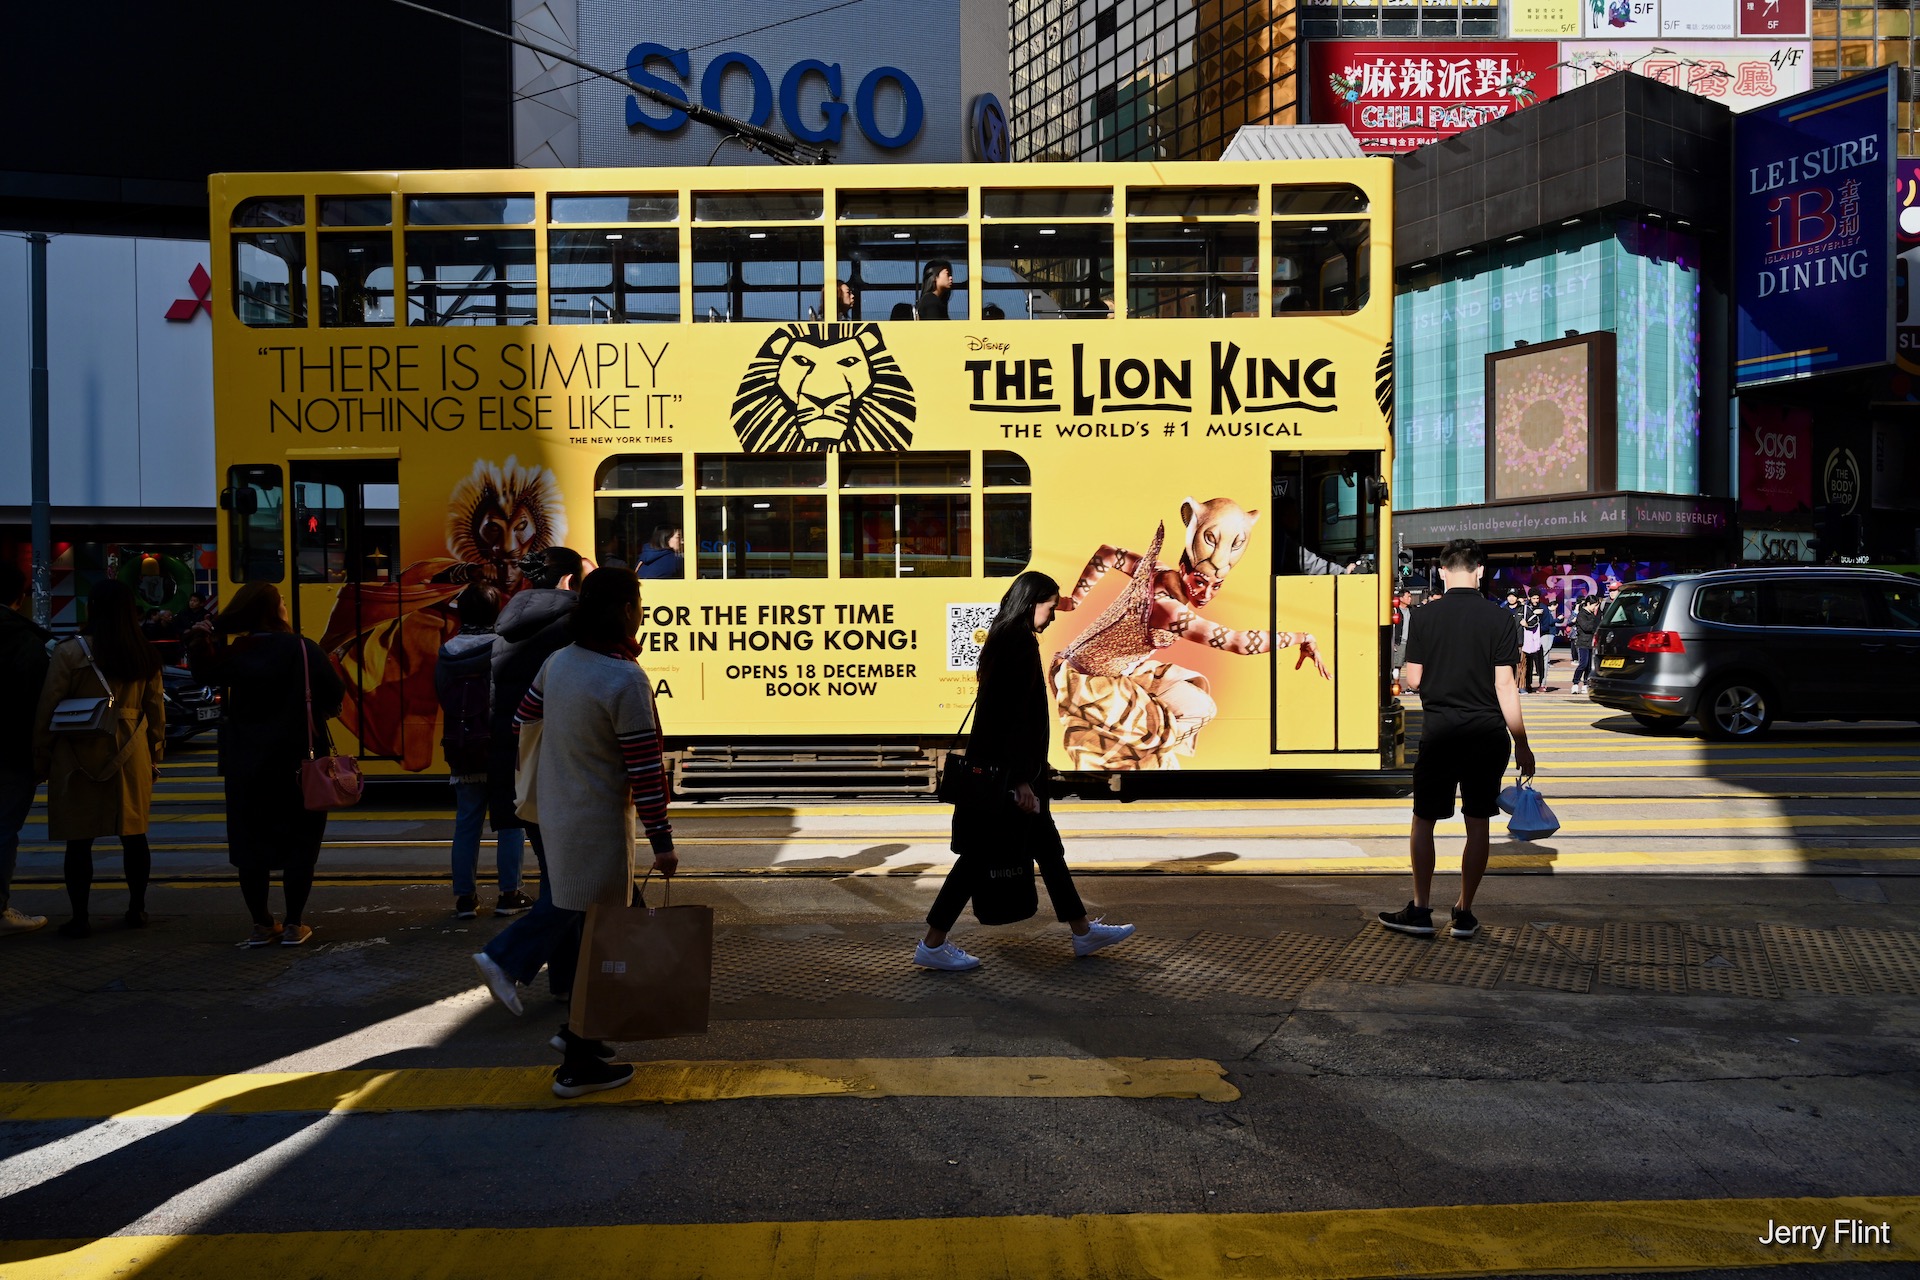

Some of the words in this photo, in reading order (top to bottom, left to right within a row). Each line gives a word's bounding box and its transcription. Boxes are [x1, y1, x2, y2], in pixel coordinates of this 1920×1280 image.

[1634, 3, 1654, 15] 5/F
[1561, 23, 1576, 33] 5/F
[1664, 20, 1680, 30] 5/F
[1767, 20, 1779, 29] 5F
[1769, 47, 1804, 71] 4/F
[1360, 58, 1511, 98] 麻辣派對
[625, 42, 924, 149] SOGO
[1361, 105, 1424, 128] CHILI
[1429, 105, 1509, 128] PARTY
[1749, 133, 1878, 195] LEISURE
[1764, 249, 1803, 265] ISLAND
[1807, 236, 1861, 257] BEVERLEY
[1757, 249, 1869, 298] DINING
[1415, 302, 1481, 330] ISLAND
[1492, 273, 1592, 311] BEVERLEY
[966, 335, 1011, 354] Disney
[442, 343, 479, 391] IS
[500, 342, 669, 390] SIMPLY
[964, 358, 1053, 402] THE
[1072, 342, 1192, 416] LION
[1209, 340, 1338, 416] KING
[270, 397, 466, 433] NOTHING
[479, 397, 552, 431] ELSE
[569, 396, 630, 430] LIKE
[1000, 423, 1042, 438] THE
[1164, 422, 1189, 438] #1
[1207, 421, 1303, 438] MUSICAL
[646, 436, 673, 444] TIMES
[1764, 460, 1787, 480] 莎莎
[1836, 468, 1849, 480] THE
[1831, 479, 1854, 492] BODY
[1430, 512, 1588, 533] www.islandbeverley.com.hk
[1600, 510, 1617, 521] Ad
[1637, 510, 1672, 522] ISLAND
[1675, 511, 1719, 525] BEVERLEY
[641, 606, 691, 626] FOR
[701, 605, 747, 625] THE
[759, 605, 825, 625] FIRST
[834, 604, 894, 624] TIME
[690, 631, 717, 651] IN
[729, 630, 813, 651] HONG
[824, 629, 918, 651] KONG!
[672, 665, 680, 673] by
[726, 665, 787, 680] OPENS
[796, 665, 816, 679] 18
[823, 664, 917, 679] DECEMBER
[766, 682, 820, 697] BOOK
[828, 682, 877, 697] NOW
[989, 866, 1024, 880] UNIQLO
